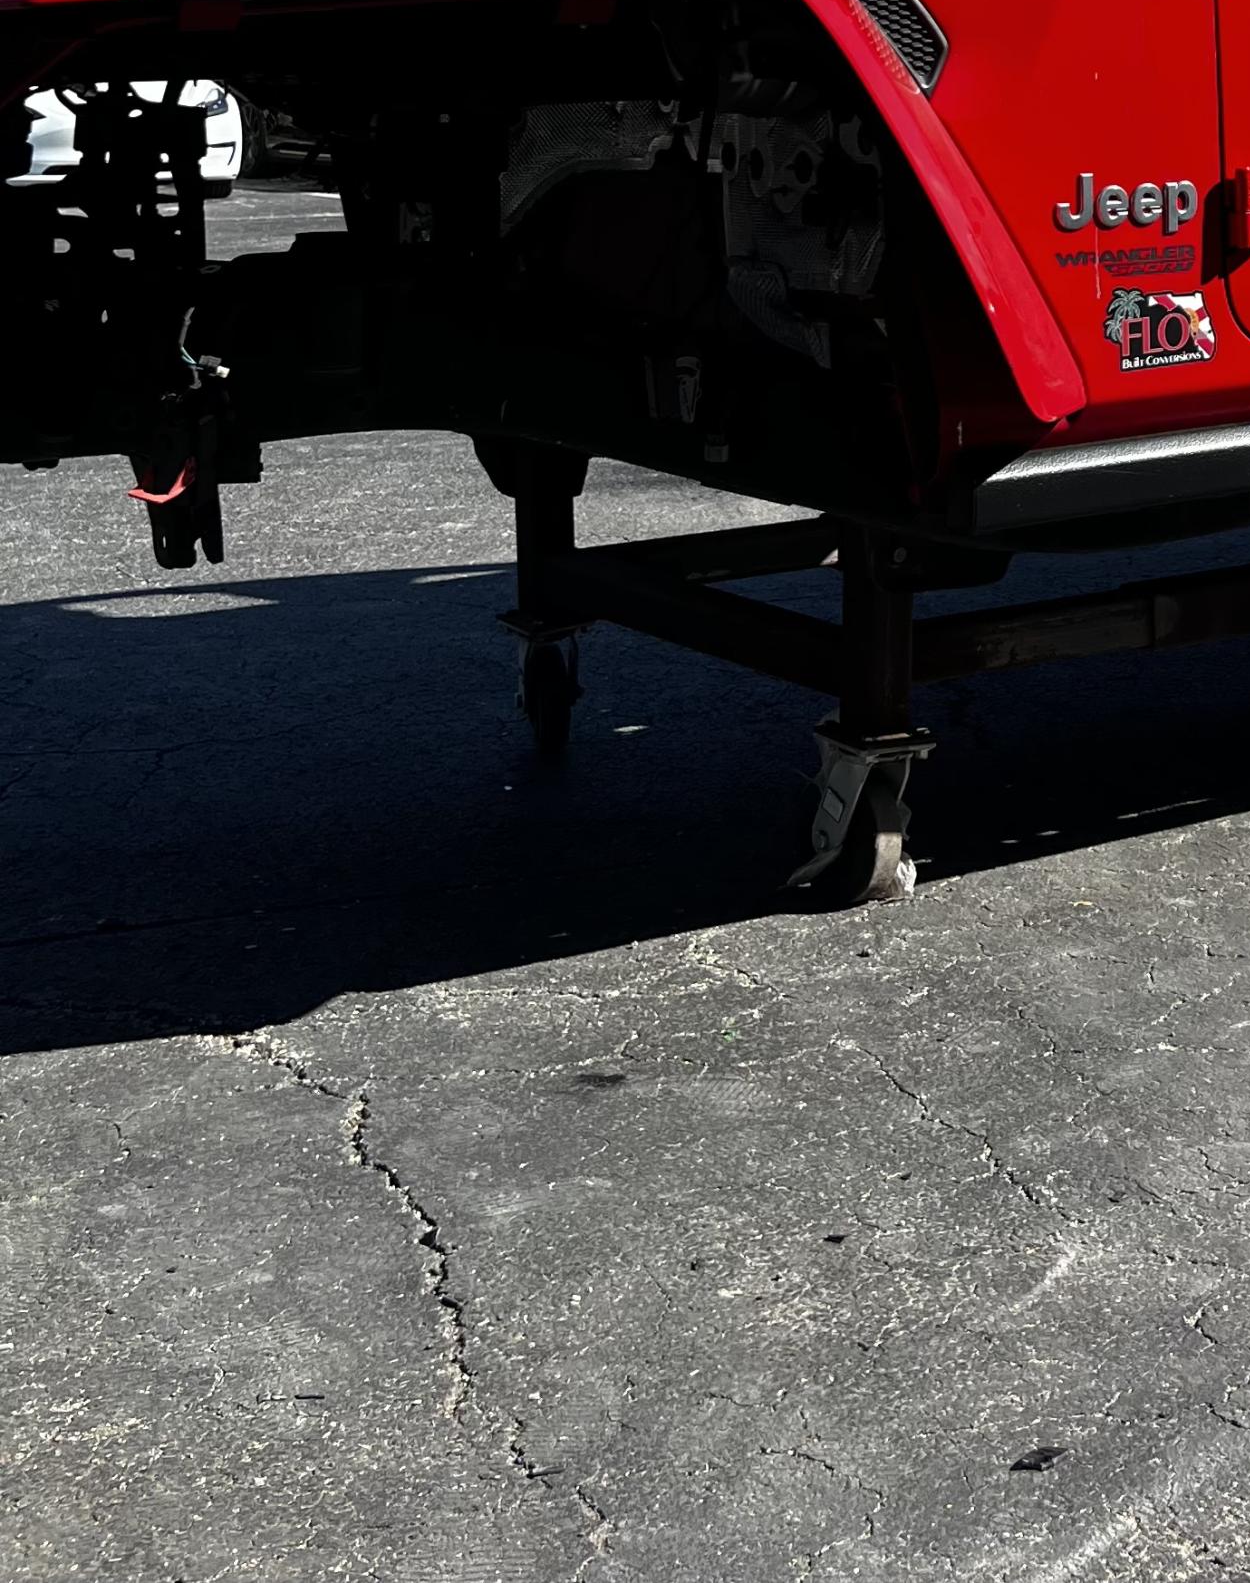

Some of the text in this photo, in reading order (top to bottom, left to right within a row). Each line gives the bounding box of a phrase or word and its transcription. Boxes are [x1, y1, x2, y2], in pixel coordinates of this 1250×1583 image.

[1055, 172, 1199, 234] Jeep
[1055, 245, 1195, 267] WRANGLER
[1121, 312, 1191, 357] FLO
